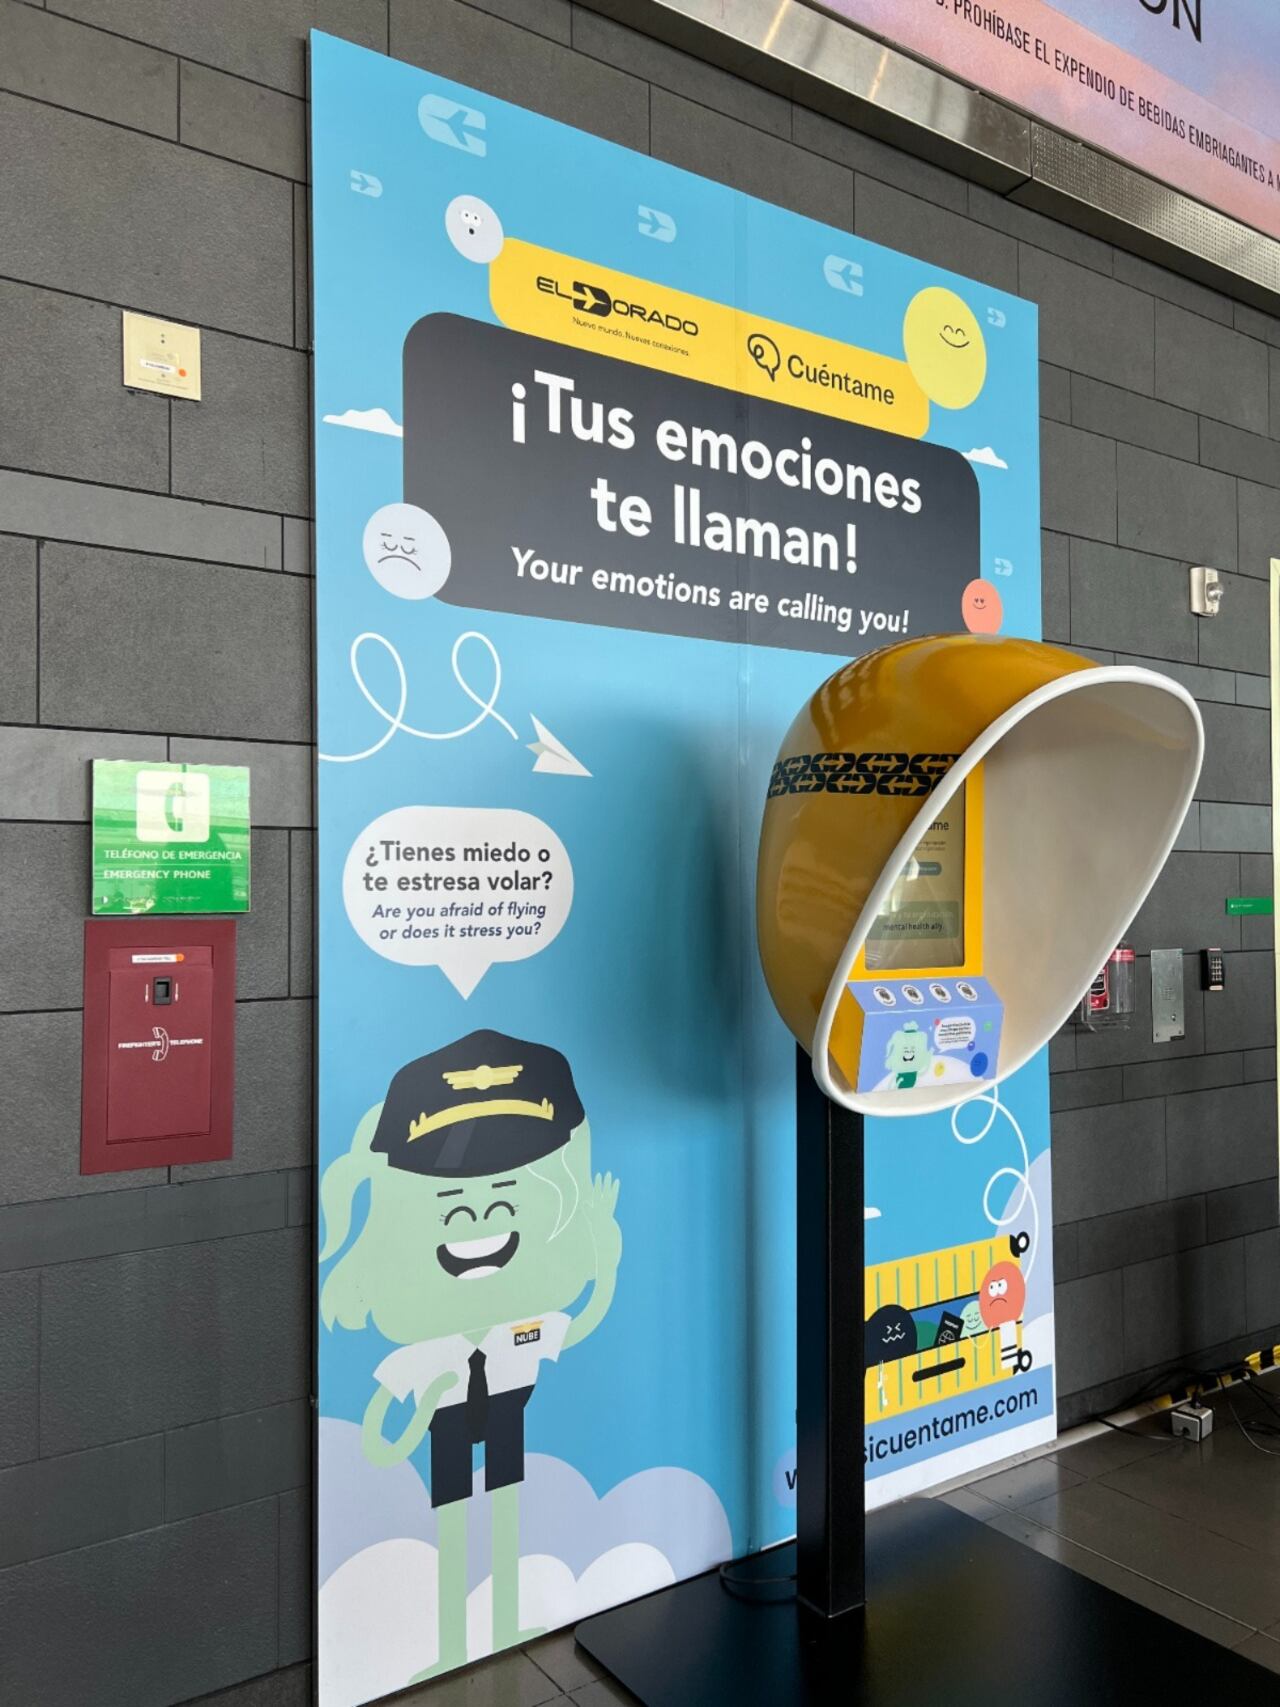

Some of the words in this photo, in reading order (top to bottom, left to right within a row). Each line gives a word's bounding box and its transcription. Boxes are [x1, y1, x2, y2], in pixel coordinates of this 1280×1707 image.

[1139, 0, 1202, 43] N
[954, 0, 1030, 54] PROHÍBASE
[1035, 38, 1050, 65] EL
[1055, 49, 1115, 101] EXPENDIO
[1119, 85, 1135, 111] DE
[1138, 96, 1186, 139] BEBIDAS
[1189, 124, 1265, 183] EMBRIAGANTES
[1268, 170, 1274, 188] A
[536, 276, 573, 300] EL
[572, 316, 597, 330] Nuevo
[625, 331, 651, 346] Nuevas
[652, 341, 689, 356] conexiones
[787, 354, 895, 405] Cuéntame
[511, 369, 635, 450] ¡Tus
[656, 419, 922, 514] emociones
[590, 477, 653, 537] te
[673, 484, 857, 574] llaman!
[511, 547, 583, 586] Your
[591, 567, 721, 607] emotions
[729, 587, 770, 614] are
[777, 592, 852, 633] calling
[858, 609, 909, 636] you!
[104, 848, 159, 860] TELÉFONO
[162, 850, 176, 860] DE
[178, 849, 242, 860] EMERGENCIA
[365, 840, 456, 867] ¿Tienes
[463, 842, 531, 862] miedo
[538, 849, 551, 863] o
[103, 870, 170, 879] EMERGENCY
[173, 870, 211, 879] PHONE
[363, 872, 388, 891] te
[397, 872, 480, 891] estresa
[487, 870, 553, 891] volar?
[372, 904, 401, 919] Are
[406, 905, 435, 922] you
[440, 902, 483, 917] afraid
[488, 901, 504, 917] of
[507, 901, 546, 919] flying
[379, 927, 397, 940] or
[402, 924, 439, 939] does
[444, 924, 455, 938] it
[459, 924, 502, 937] stress
[505, 921, 542, 940] you?
[516, 1330, 539, 1344] NUBE
[864, 1387, 1038, 1464] icuentame.com
